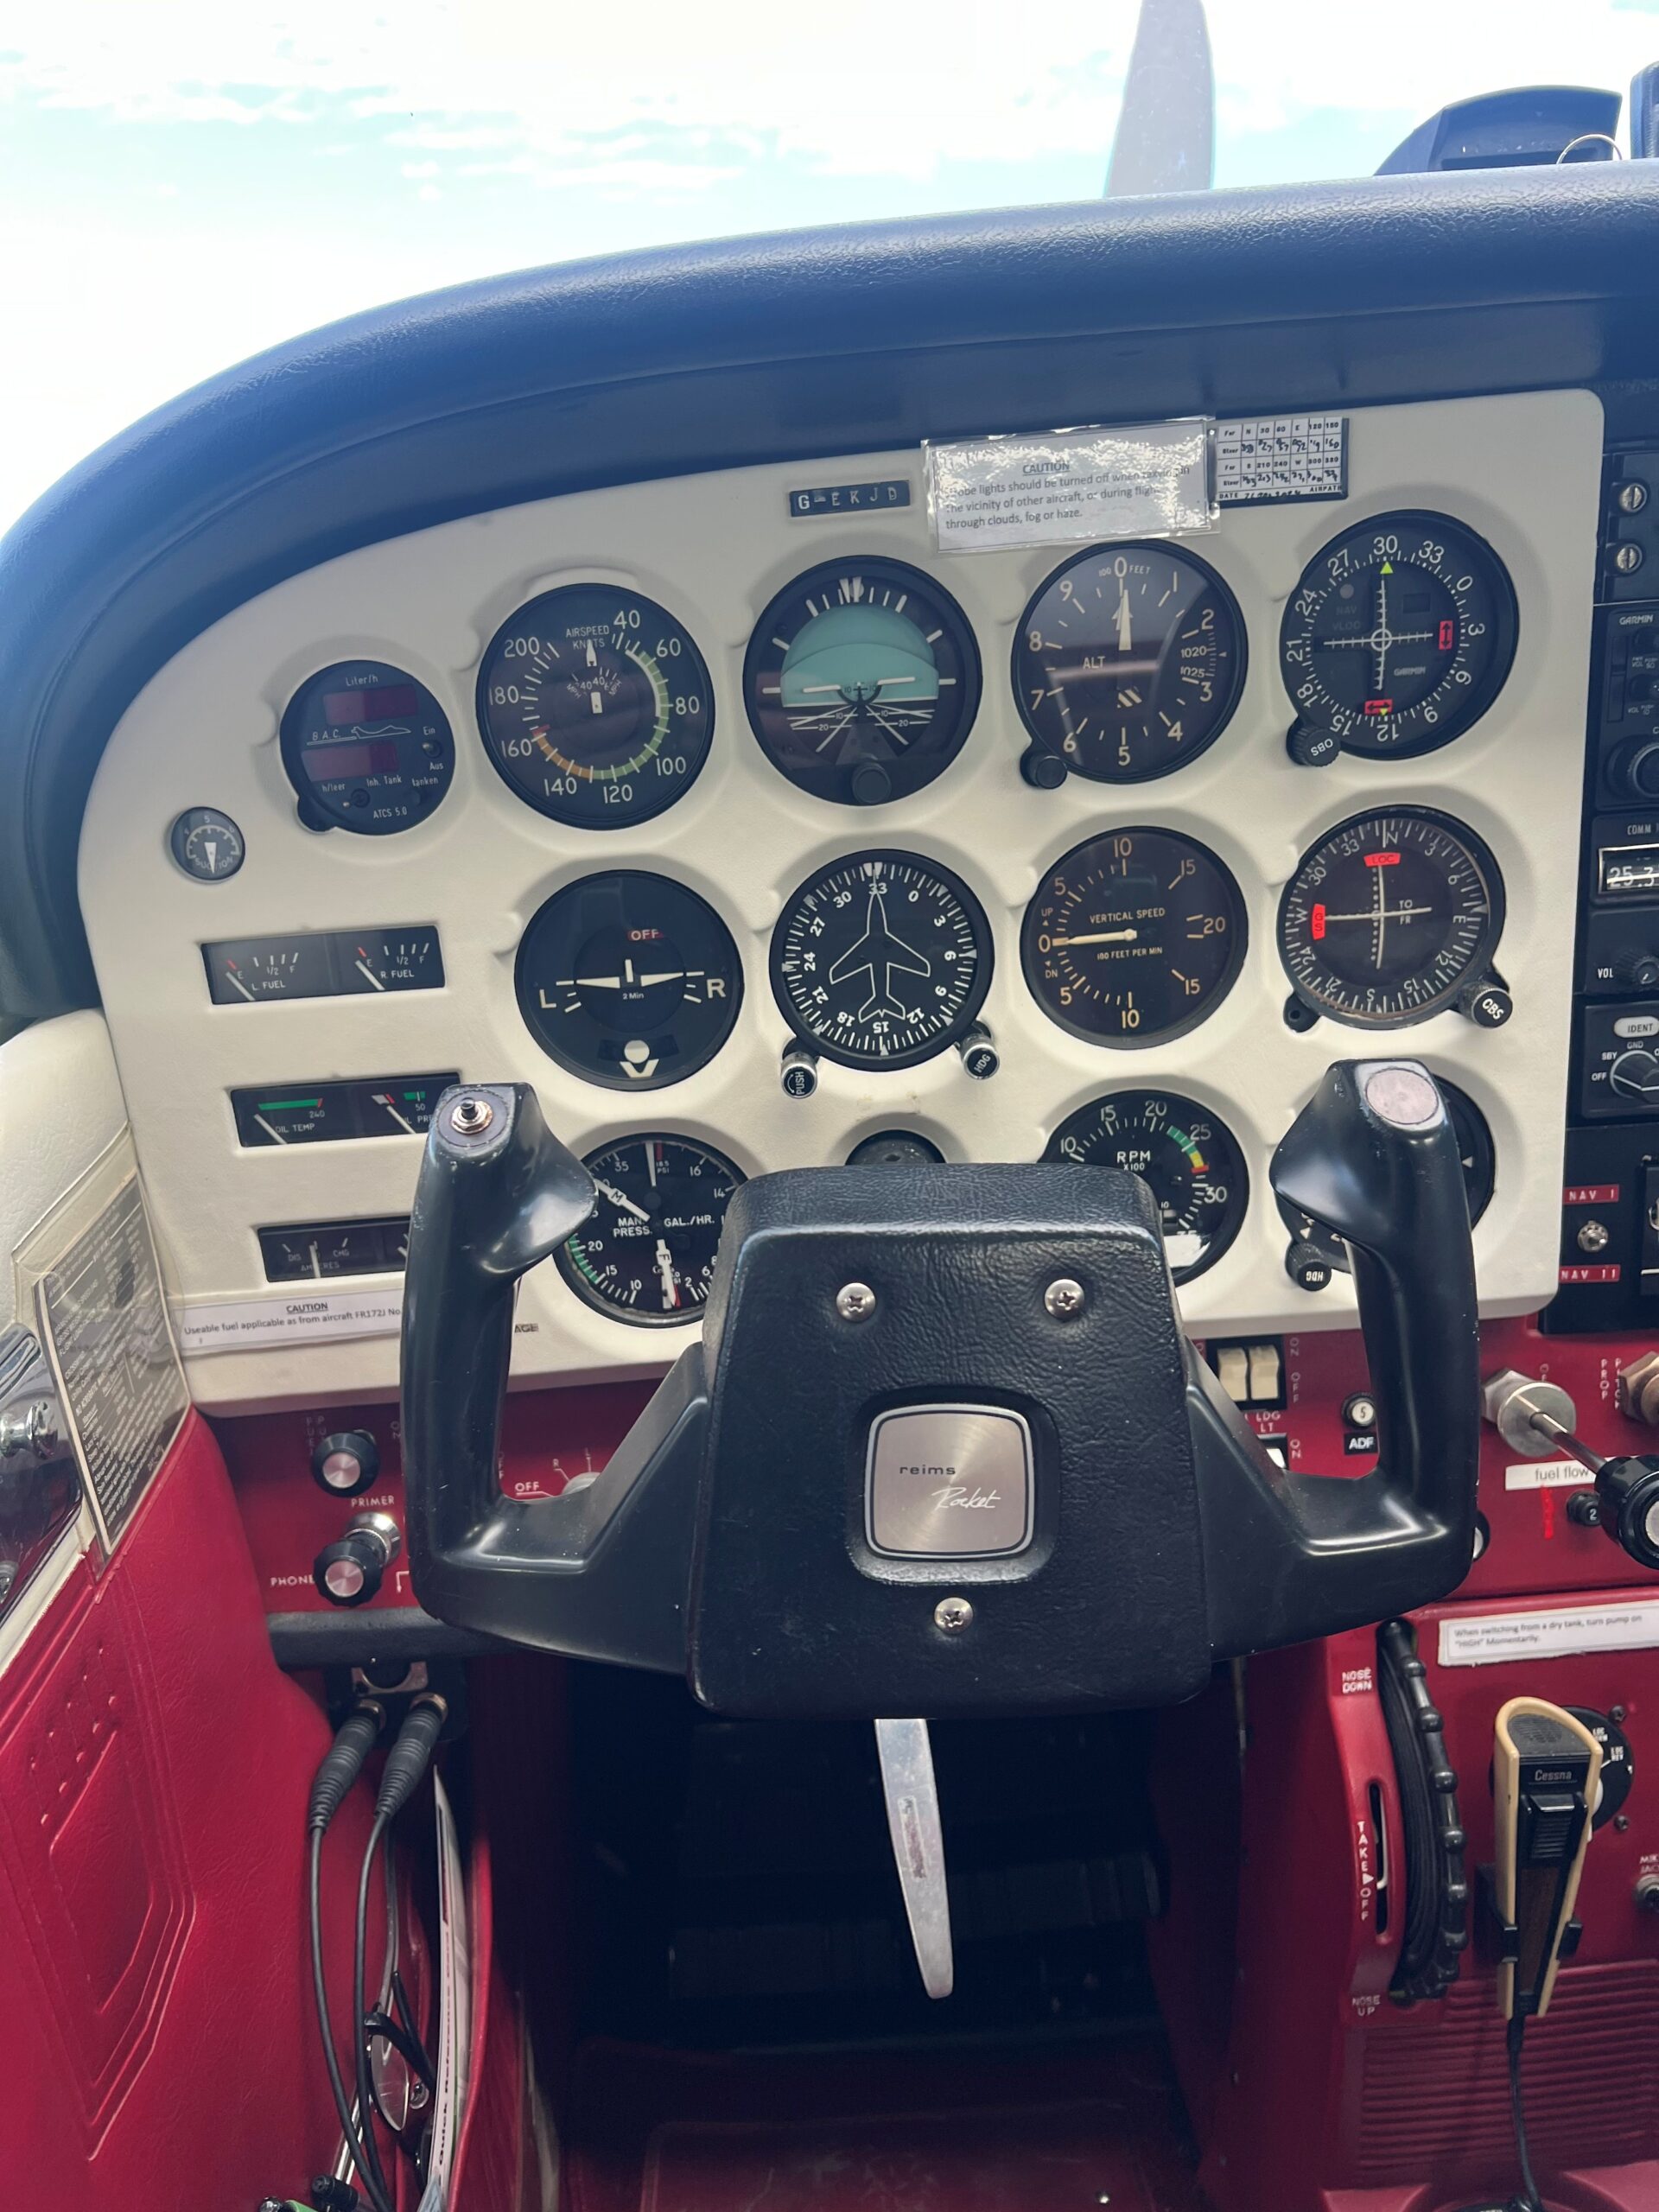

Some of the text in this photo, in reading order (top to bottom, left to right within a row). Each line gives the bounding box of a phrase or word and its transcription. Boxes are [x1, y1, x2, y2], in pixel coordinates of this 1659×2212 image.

[1022, 462, 1070, 474] CAUTION
[978, 482, 1006, 497] lights
[1008, 479, 1041, 493] should
[1044, 477, 1056, 489] be
[1059, 474, 1093, 488] turned
[1096, 472, 1110, 484] off
[966, 486, 1132, 512] vicinity of other aircraft, or during
[946, 508, 1083, 531] through clouds, fog or haze.
[1373, 535, 1398, 554] 30
[1418, 541, 1445, 564] 33
[1129, 564, 1151, 575] FEET
[1327, 549, 1351, 576] 27
[1294, 588, 1318, 616] 24
[1619, 614, 1654, 626] GARMIN
[566, 625, 609, 638] AIRSPEED
[504, 636, 541, 658] 200
[657, 639, 681, 658] 60
[1286, 639, 1304, 662] 21
[1083, 656, 1106, 670] ALT
[346, 674, 378, 687] Liter/h
[489, 685, 518, 707] 180
[1297, 683, 1319, 709] 18
[675, 696, 701, 715] 80
[423, 726, 435, 735] Ein
[1330, 714, 1352, 736] 15
[1376, 723, 1400, 742] 12
[501, 739, 532, 760] 160
[1310, 737, 1334, 757] OBS
[429, 762, 443, 771] Aus
[657, 757, 686, 776] 100
[321, 782, 346, 792] h/leer
[366, 775, 402, 787] Inh. Tank
[411, 776, 439, 787] tanken
[544, 777, 578, 797] 140
[603, 784, 633, 804] 120
[373, 806, 408, 819] ATCS 5.0
[1627, 824, 1651, 836] COMM
[1114, 837, 1132, 858] 10
[1341, 839, 1361, 857] 33
[1181, 858, 1196, 876] 15
[1371, 854, 1395, 864] LOC
[1308, 866, 1327, 886] 30
[832, 891, 852, 908] 30
[1041, 907, 1053, 917] UP
[1090, 907, 1166, 925] VERTICAL SPEED
[810, 917, 826, 937] 27
[1203, 916, 1225, 934] 20
[631, 928, 659, 941] OFF
[1111, 947, 1163, 959] FEET PER MIN
[1300, 946, 1316, 965] 24
[1435, 949, 1454, 966] 12
[804, 951, 817, 972] 24
[391, 969, 415, 978] FUEL
[1045, 969, 1058, 979] DN
[1597, 967, 1613, 978] VOL
[263, 979, 286, 989] FUEL
[1185, 979, 1200, 995] 15
[1325, 976, 1342, 993] 21
[1403, 977, 1421, 995] 15
[628, 991, 645, 1000] Min
[811, 985, 830, 1004] 21
[906, 1007, 925, 1025] 12
[1482, 997, 1504, 1020] OBS
[836, 1011, 855, 1027] 18
[1122, 1009, 1140, 1029] 10
[1628, 1023, 1653, 1033] IDENT
[1627, 1039, 1643, 1049] GND
[974, 1053, 991, 1073] HDG
[1602, 1052, 1618, 1061] SBY
[796, 1071, 804, 1096] PUSH
[1591, 1071, 1606, 1081] OFF
[1101, 1105, 1116, 1122] 15
[1145, 1100, 1167, 1116] 20
[275, 1123, 315, 1134] OIL TEMP
[1190, 1124, 1211, 1141] 25
[1060, 1136, 1077, 1154] 10
[1117, 1151, 1151, 1162] RPM
[690, 1166, 702, 1176] 16
[714, 1188, 725, 1198] 14
[1204, 1186, 1227, 1203] 30
[1568, 1190, 1597, 1201] NAV
[613, 1227, 652, 1238] PRESS.
[333, 1249, 350, 1257] CHG
[588, 1241, 604, 1251] 20
[288, 1253, 302, 1262] DIS
[606, 1265, 618, 1276] 15
[1306, 1270, 1324, 1281] HDG
[1561, 1269, 1589, 1281] NAV
[631, 1280, 642, 1291] 10
[286, 1302, 328, 1313] CAUTION
[184, 1324, 219, 1335] Useable
[221, 1321, 238, 1332] fuel
[241, 1318, 285, 1331] applicable
[299, 1315, 321, 1324] from
[322, 1312, 353, 1323] aircraft
[355, 1309, 386, 1319] FR172J
[1600, 1358, 1610, 1401] PROP
[1255, 1411, 1281, 1422] LDG
[1260, 1423, 1274, 1433] LT
[1349, 1437, 1375, 1450] ADF
[899, 1464, 957, 1476] reims
[1535, 1465, 1589, 1481] fuel flow
[515, 1482, 540, 1493] OFF
[351, 1495, 395, 1508] PRIMER
[931, 1484, 1001, 1511] Rocket
[1454, 1628, 1478, 1637] When
[1481, 1624, 1519, 1635] switching
[1521, 1623, 1540, 1631] from
[1549, 1620, 1562, 1630] dry
[1564, 1618, 1585, 1628] tank,
[1605, 1615, 1630, 1625] pump
[1342, 1668, 1371, 1681] NOSE
[1342, 1680, 1372, 1694] DOWN
[1535, 1769, 1573, 1782] Cessna
[1357, 1821, 1370, 1872] TAKE
[1360, 1887, 1370, 1921] OFF
[1351, 1994, 1381, 2006] NOSE
[1357, 2005, 1376, 2016] UP
